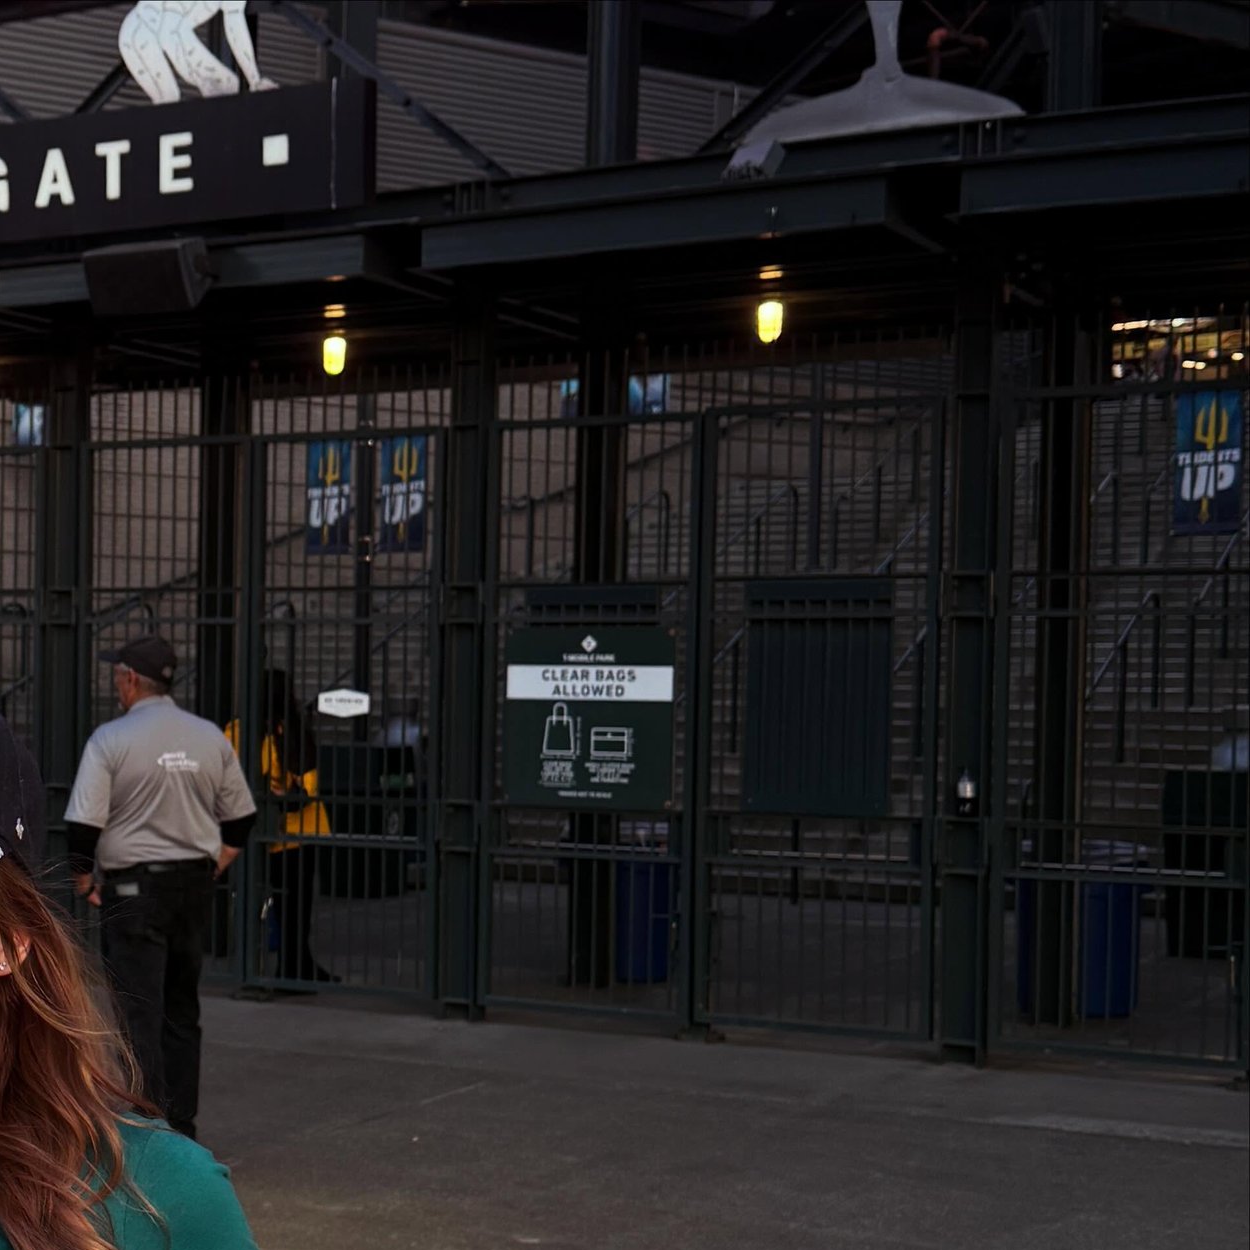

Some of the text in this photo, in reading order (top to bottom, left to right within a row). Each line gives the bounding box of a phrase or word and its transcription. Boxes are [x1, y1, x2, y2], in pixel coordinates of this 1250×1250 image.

[541, 668, 637, 682] CLEAR BAGS
[551, 683, 626, 698] ALLOWED
